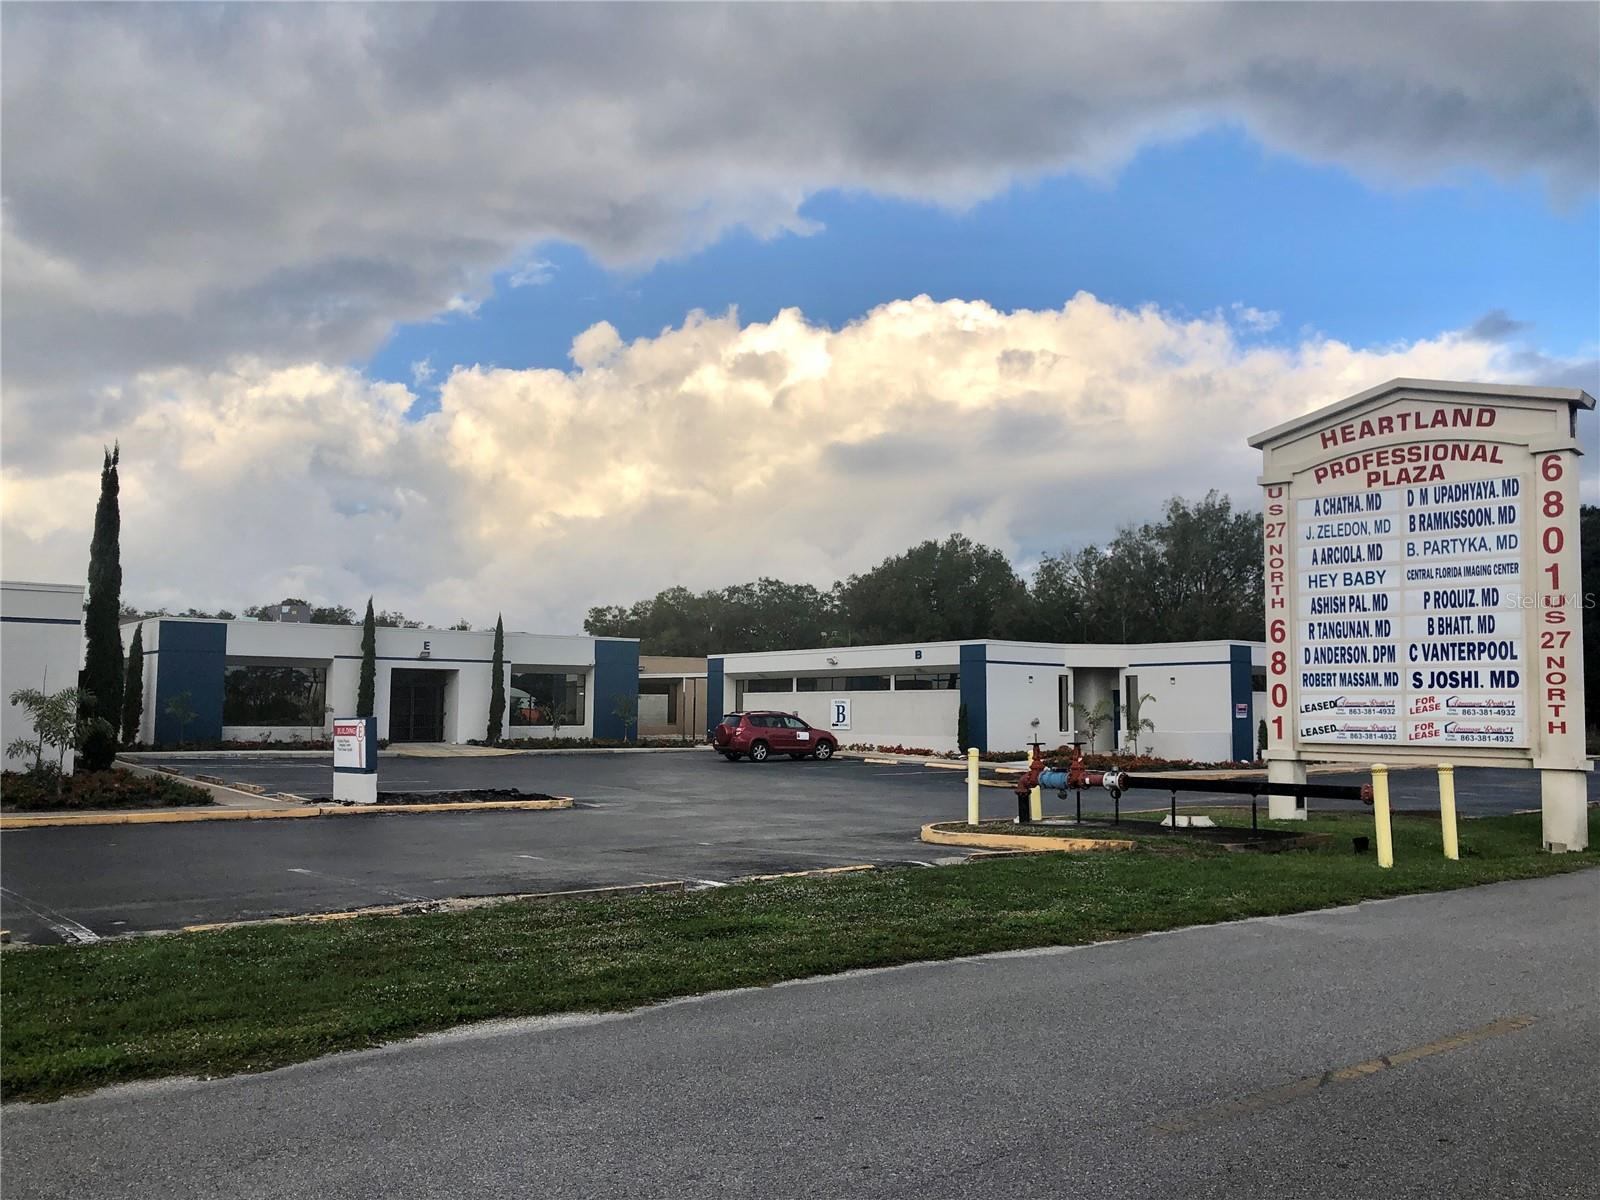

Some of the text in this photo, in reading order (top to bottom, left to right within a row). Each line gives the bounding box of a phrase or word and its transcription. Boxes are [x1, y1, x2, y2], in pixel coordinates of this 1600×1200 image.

[1320, 408, 1496, 449] HEARTLAND
[1314, 444, 1503, 485] PROFESSIONAL
[1366, 464, 1445, 488] PLAZA
[1407, 489, 1415, 507] D
[1420, 488, 1429, 506] M
[1501, 478, 1520, 498] MD
[1314, 499, 1321, 517] A
[1366, 493, 1382, 511] MD
[1409, 514, 1416, 533] B
[1498, 505, 1516, 525] MD
[1541, 454, 1564, 590] 6801
[1265, 522, 1287, 538] 27
[1306, 519, 1391, 540] J. ZELEDON, MD
[1312, 548, 1318, 566] A
[1367, 543, 1383, 561] MD
[1407, 534, 1518, 557] B. PARTYKA, MD
[1269, 544, 1285, 609] NORTH
[1308, 570, 1386, 589] HEY BABY
[1406, 562, 1519, 581] CENTRAL FLORIDA IMAGING CENTER
[1311, 595, 1346, 615] ASHISH
[1372, 593, 1388, 612] MD
[1424, 591, 1431, 610] P
[1481, 587, 1499, 607] MD
[1308, 622, 1315, 640] R
[1375, 619, 1391, 638] MD
[1427, 617, 1435, 636] B
[1477, 614, 1496, 634] MD
[423, 641, 431, 651] E
[1541, 631, 1571, 649] 27
[915, 650, 922, 660] B
[1304, 647, 1311, 665] D
[1373, 645, 1396, 663] DPM
[1409, 641, 1518, 662] C VANTERPOOL
[1270, 619, 1288, 740] 6801
[1302, 672, 1337, 688] ROBERT
[1384, 671, 1399, 687] MD
[1412, 671, 1424, 689] S
[1490, 670, 1520, 688] MD
[1415, 695, 1435, 706] FOR
[1546, 656, 1567, 734] NORTH
[835, 705, 846, 723] B
[1300, 700, 1337, 713] LEASED
[1409, 703, 1441, 715] LEASE
[1301, 724, 1337, 737] LEASED
[1350, 732, 1397, 740] 863-381-4932
[1408, 729, 1440, 741] LEASE
[1414, 722, 1434, 732] FOR
[1460, 735, 1514, 743] 863-381-4932
